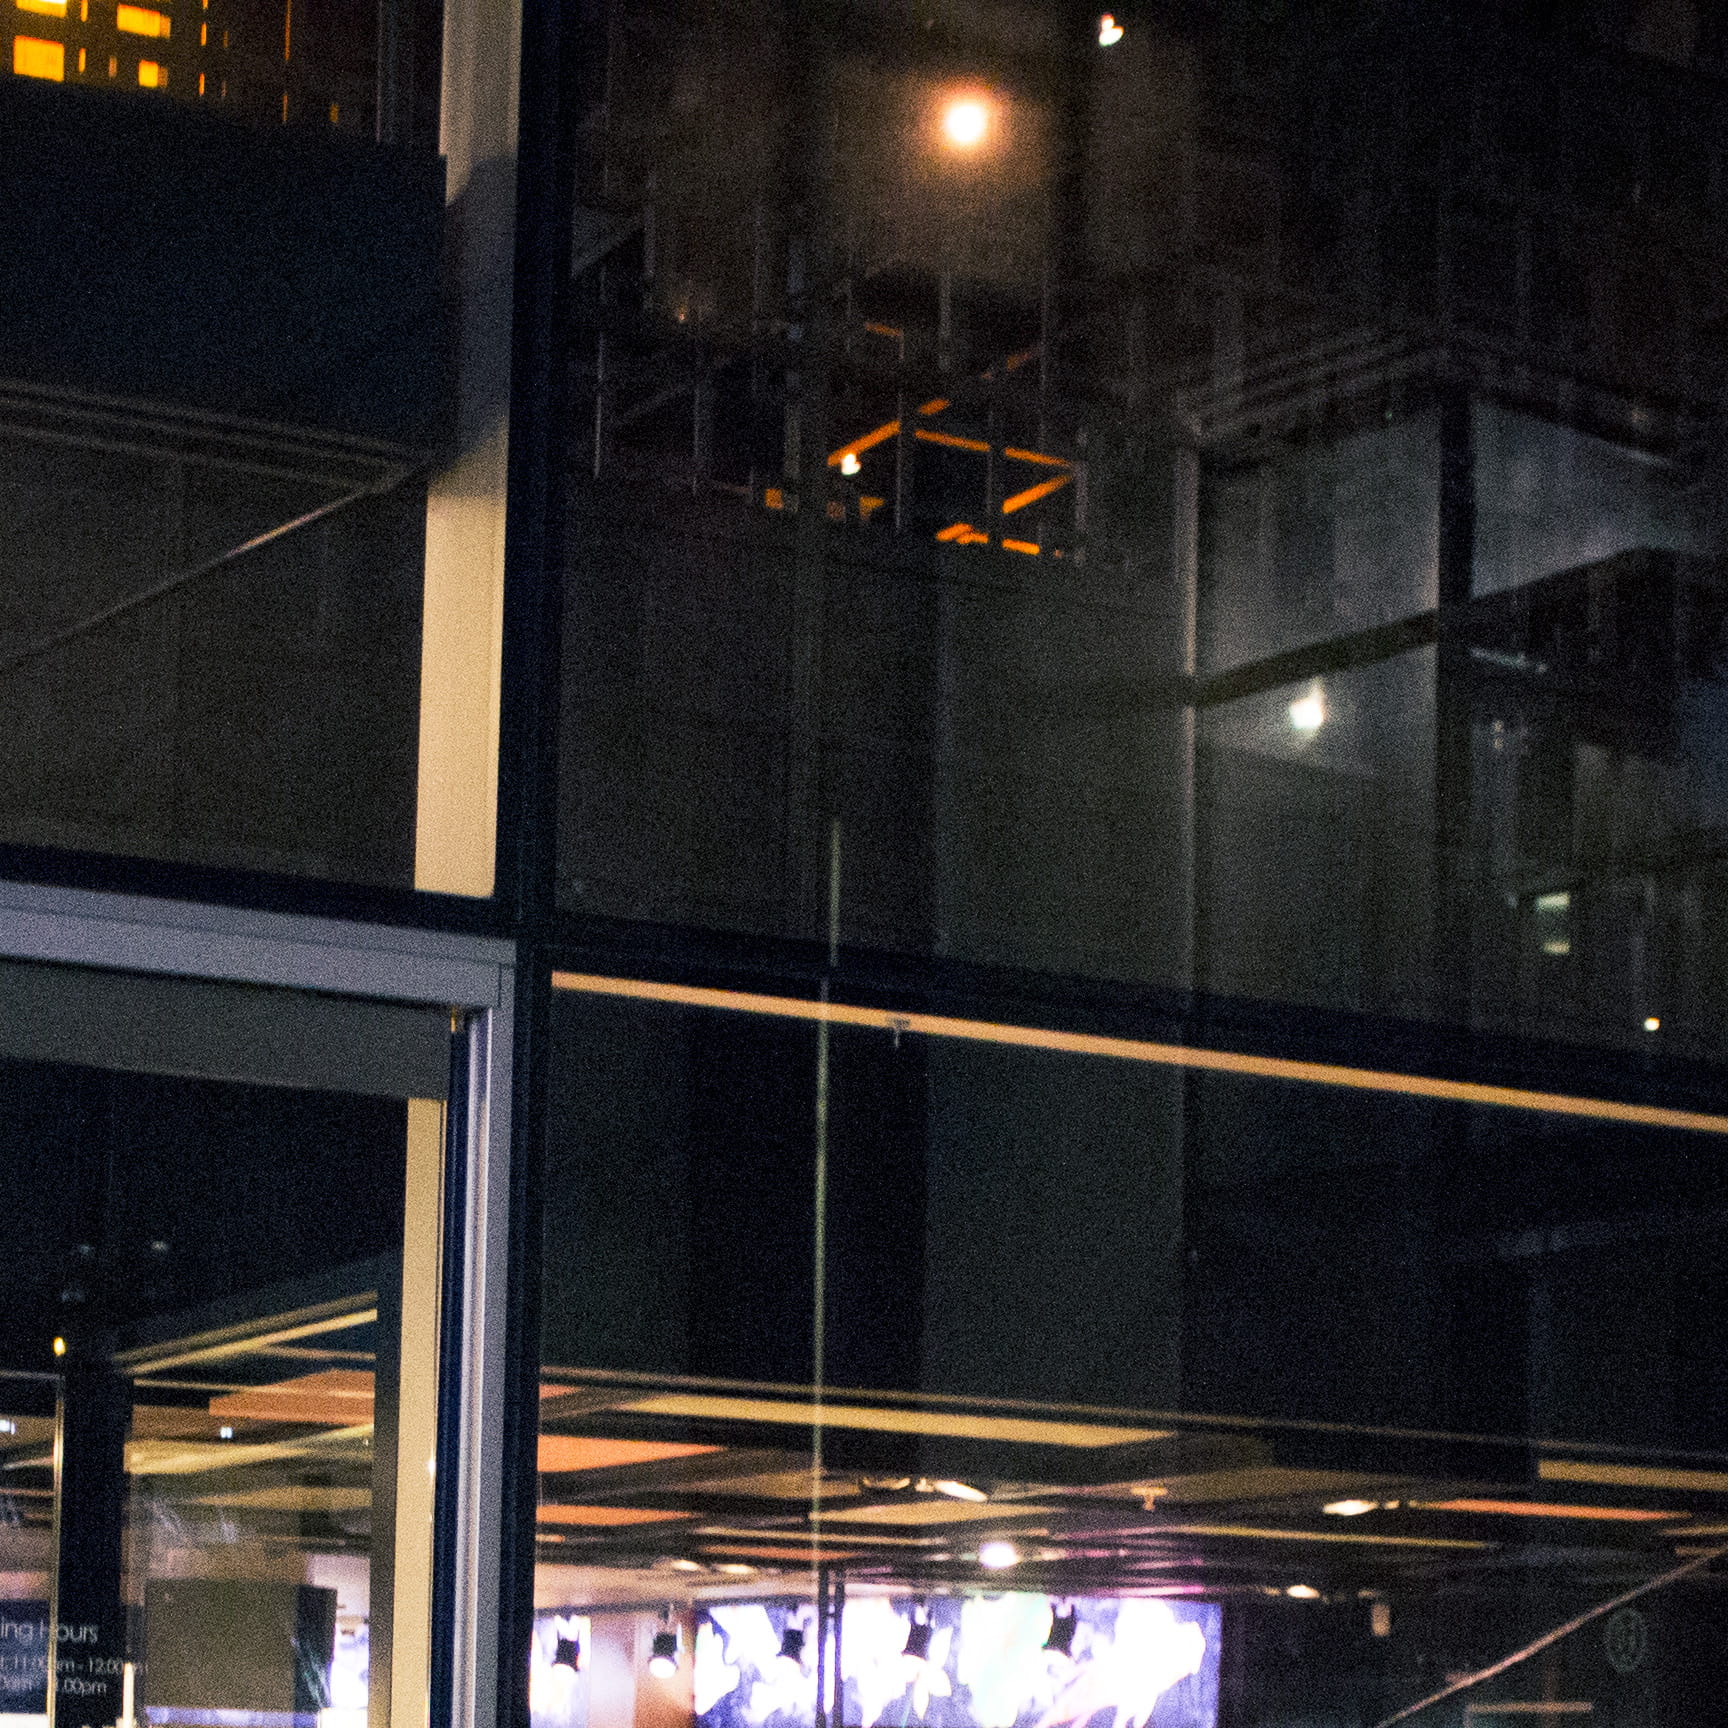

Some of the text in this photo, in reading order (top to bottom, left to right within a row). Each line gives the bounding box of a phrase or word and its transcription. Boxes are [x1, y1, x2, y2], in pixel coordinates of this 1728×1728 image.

[36, 1617, 99, 1645] Hours
[13, 1655, 76, 1674] 11.00m
[88, 1657, 148, 1676] 12.00m
